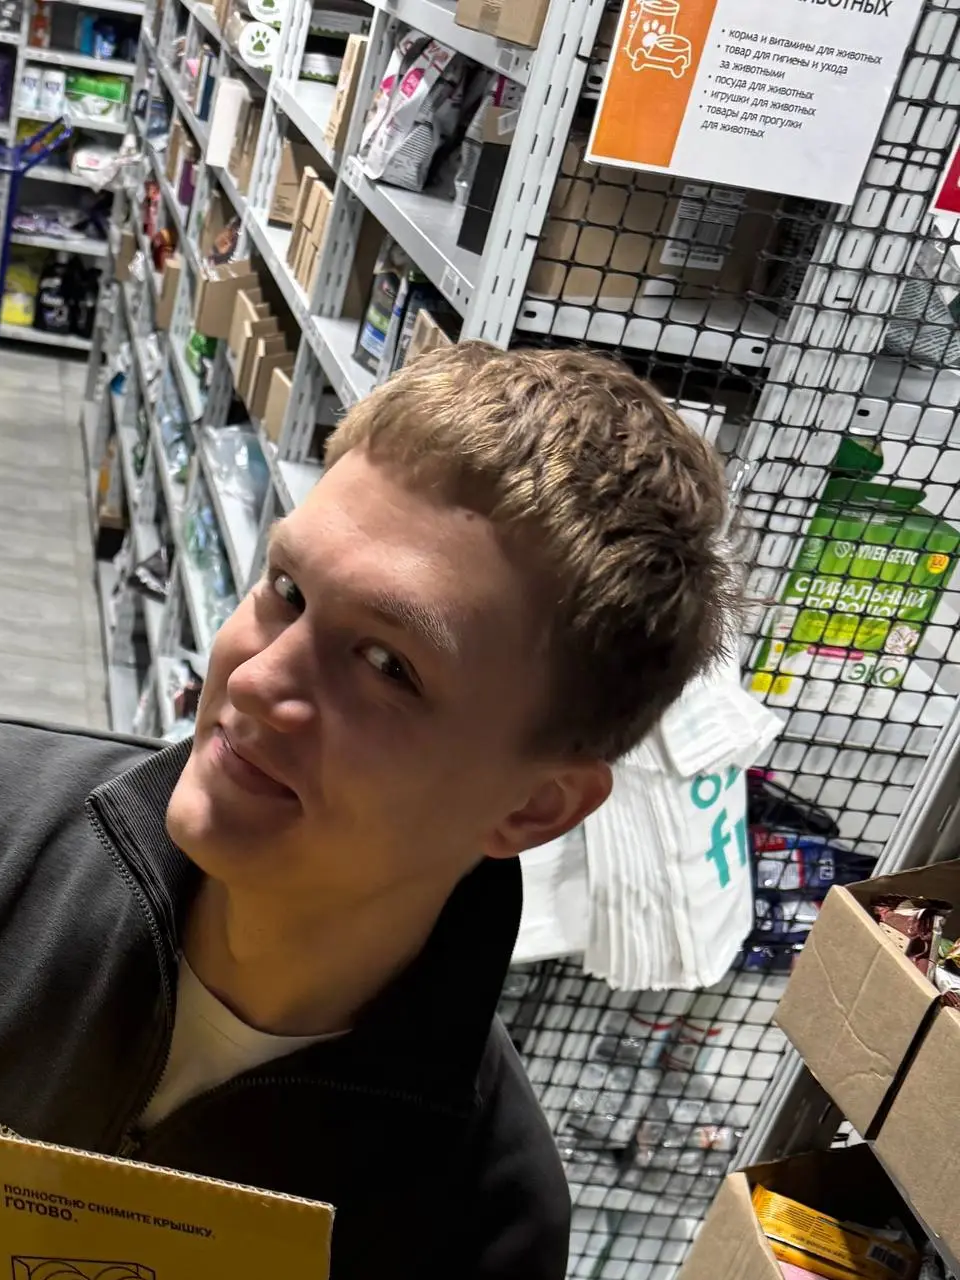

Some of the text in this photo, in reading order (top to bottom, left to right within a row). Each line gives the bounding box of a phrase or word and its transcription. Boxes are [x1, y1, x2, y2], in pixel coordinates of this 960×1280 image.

[725, 44, 848, 76] товар для гигиены и ухода
[728, 29, 883, 65] корма и витамины для животных
[719, 60, 785, 79] за животными
[715, 75, 815, 101] посуда для животных
[710, 90, 817, 117] игрушки для животных
[700, 119, 766, 138] для животных
[706, 104, 803, 130] товары для прогулки
[848, 662, 900, 687] ЭКО
[3, 1183, 87, 1211] ПОЛНОСТЬЮ
[87, 1202, 152, 1225] СНИМИТЕ
[4, 1195, 79, 1223] ГОТОВО.
